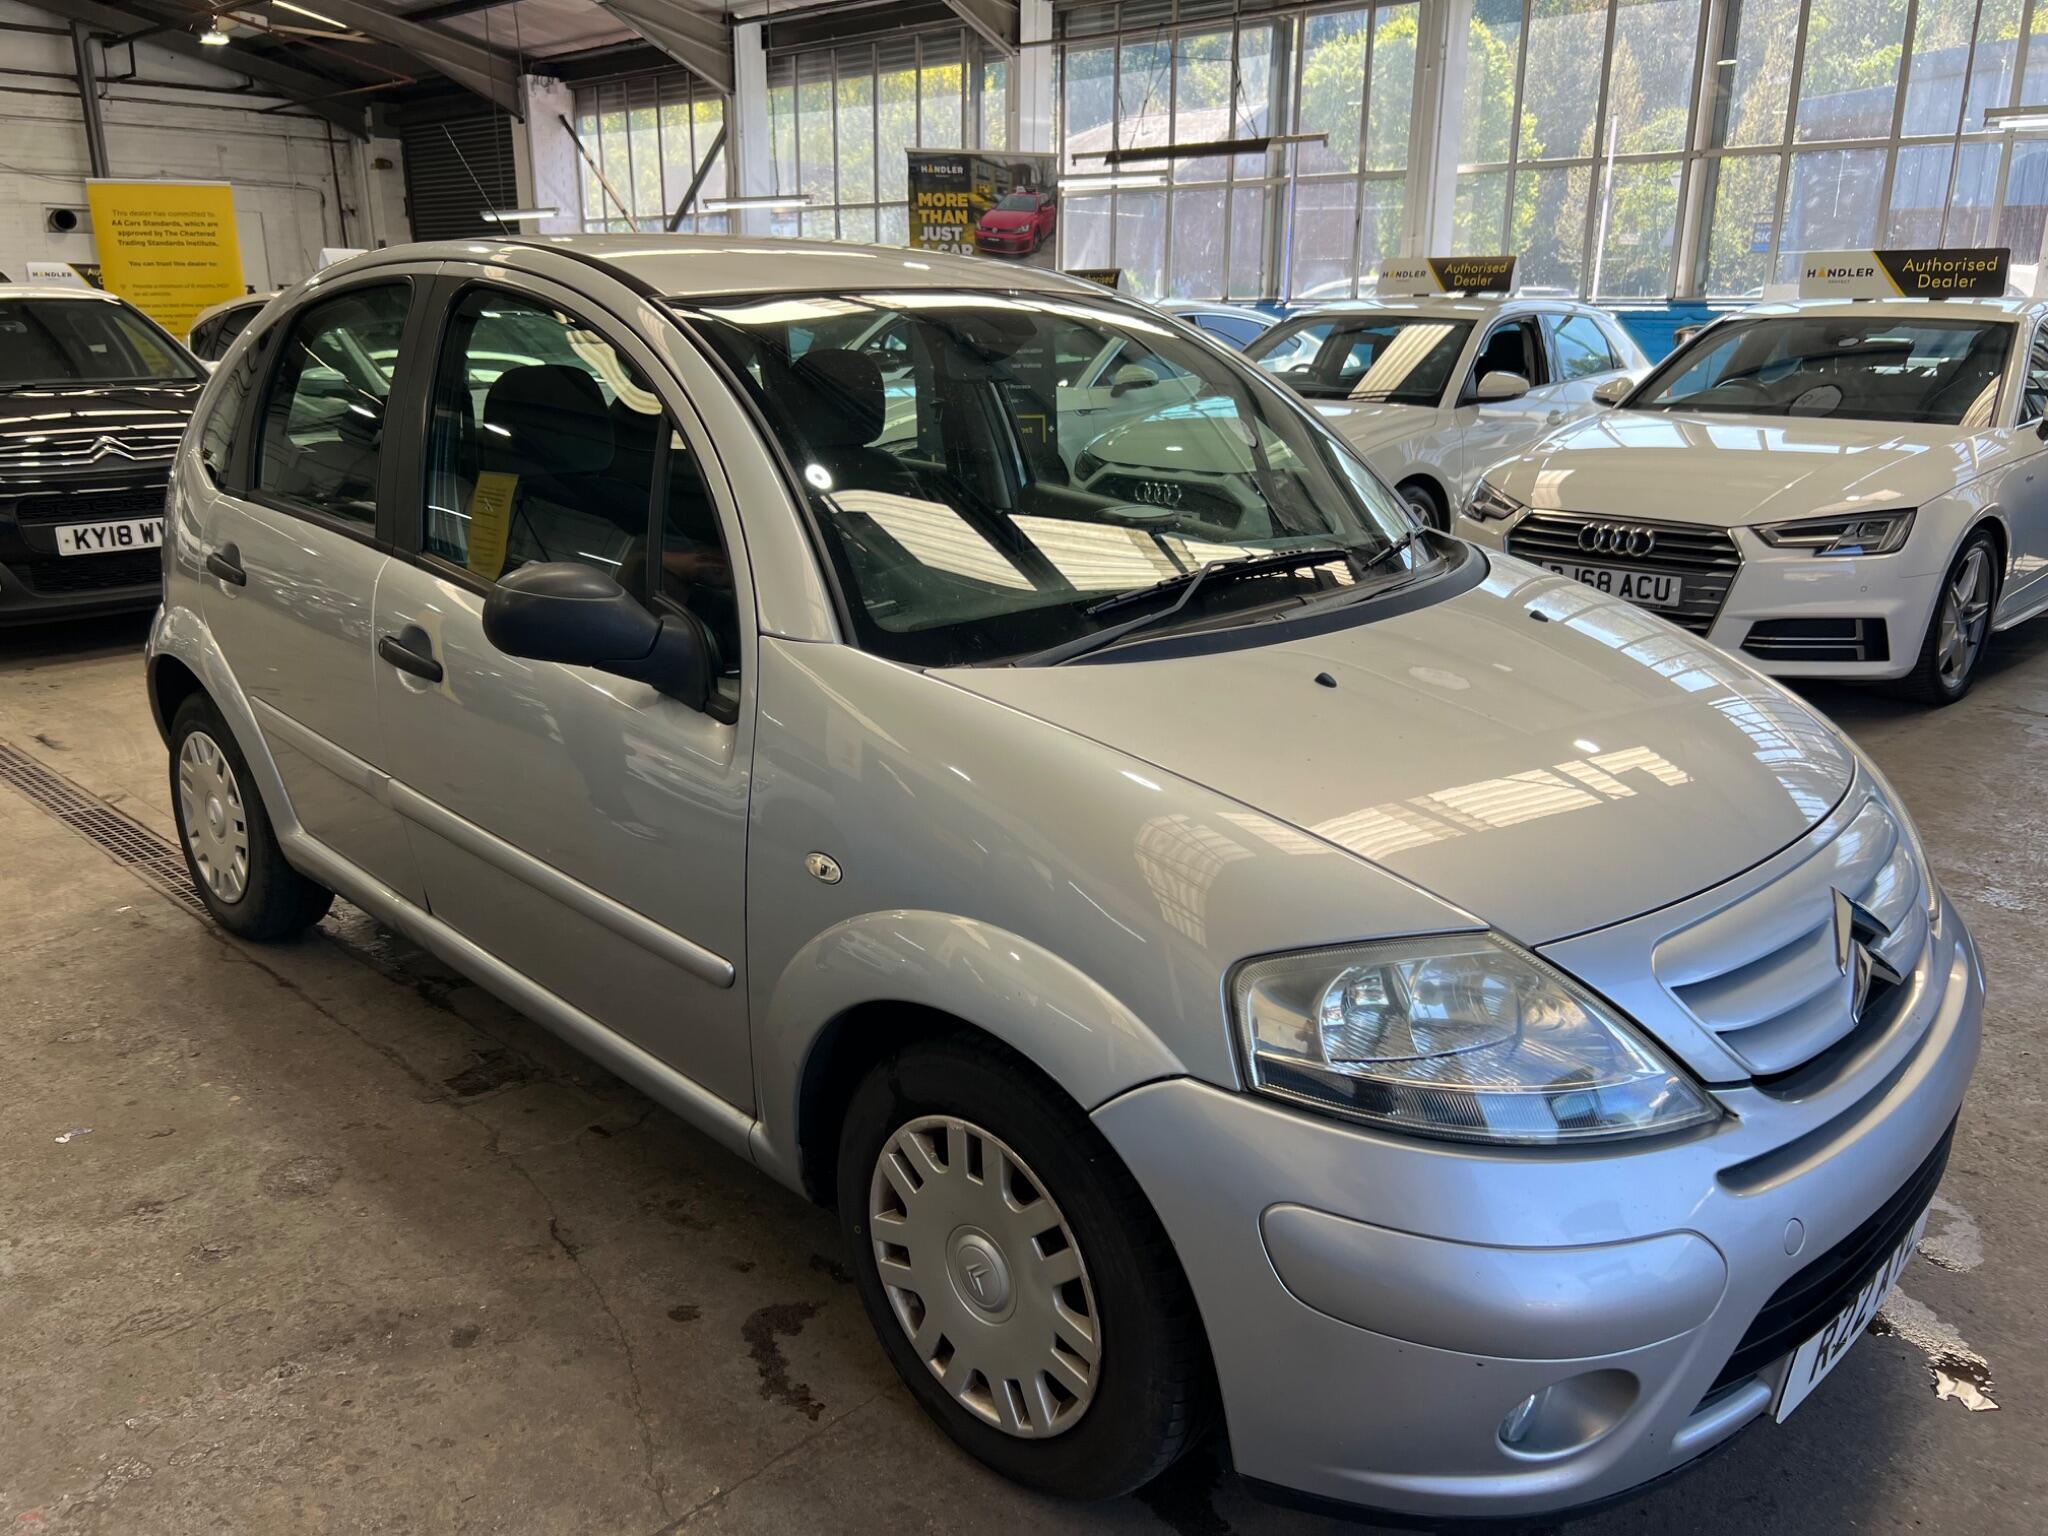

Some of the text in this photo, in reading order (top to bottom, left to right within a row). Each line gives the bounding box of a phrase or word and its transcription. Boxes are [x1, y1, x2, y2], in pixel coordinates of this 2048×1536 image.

[918, 192, 969, 207] MORE
[918, 209, 968, 224] THAN
[118, 230, 153, 238] approved
[154, 230, 163, 238] by
[919, 226, 963, 241] JUST
[118, 239, 146, 247] Trading
[1444, 262, 1508, 274] Authorised
[1807, 266, 1874, 278] HANDLER
[1902, 256, 1998, 273] Authorised
[1382, 270, 1426, 279] HANDLER
[1453, 275, 1493, 287] Dealer
[1917, 274, 1976, 289] Dealer
[73, 525, 133, 549] KY18
[1619, 574, 1671, 601] ACU
